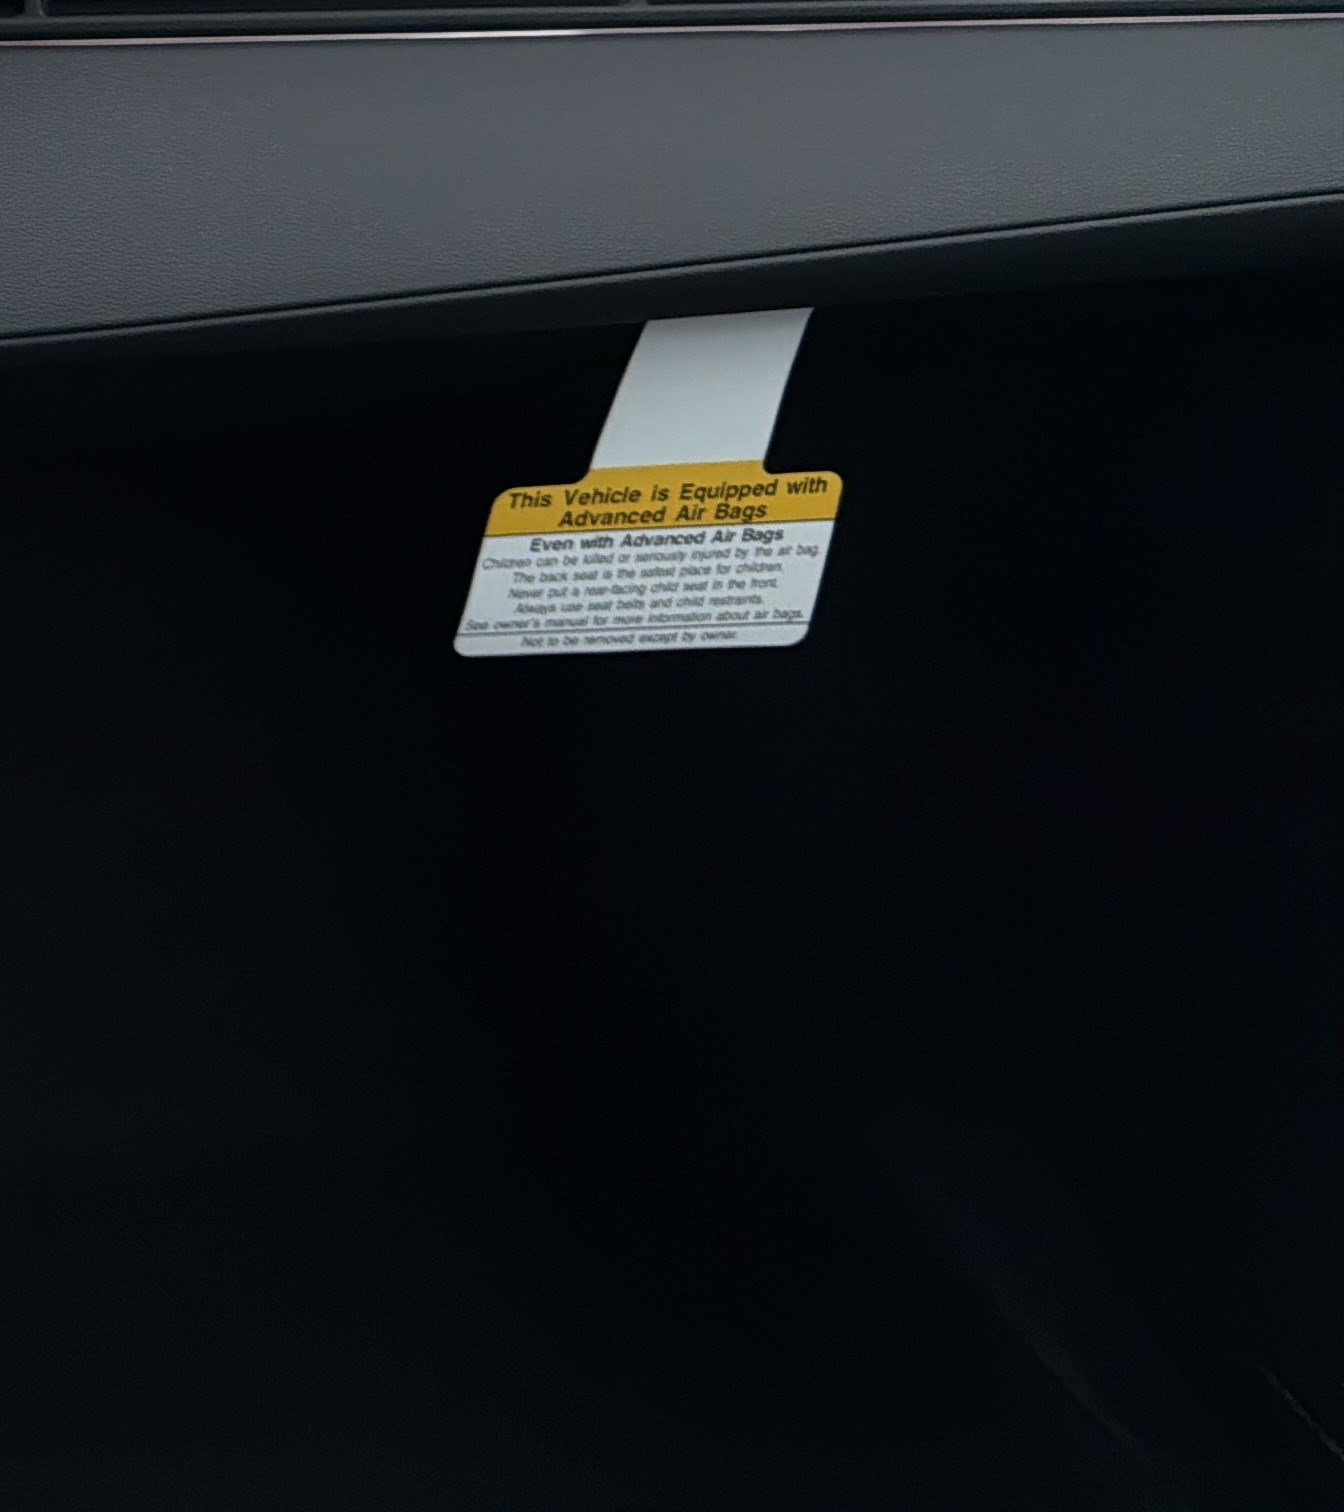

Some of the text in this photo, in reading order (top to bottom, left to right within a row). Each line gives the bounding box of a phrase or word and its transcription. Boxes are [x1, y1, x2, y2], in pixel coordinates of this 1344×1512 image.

[509, 477, 828, 509] This Vehicle is Equipped with
[558, 502, 768, 527] Advanced Air Bags
[529, 528, 785, 552] Even with Advanced Air Bags
